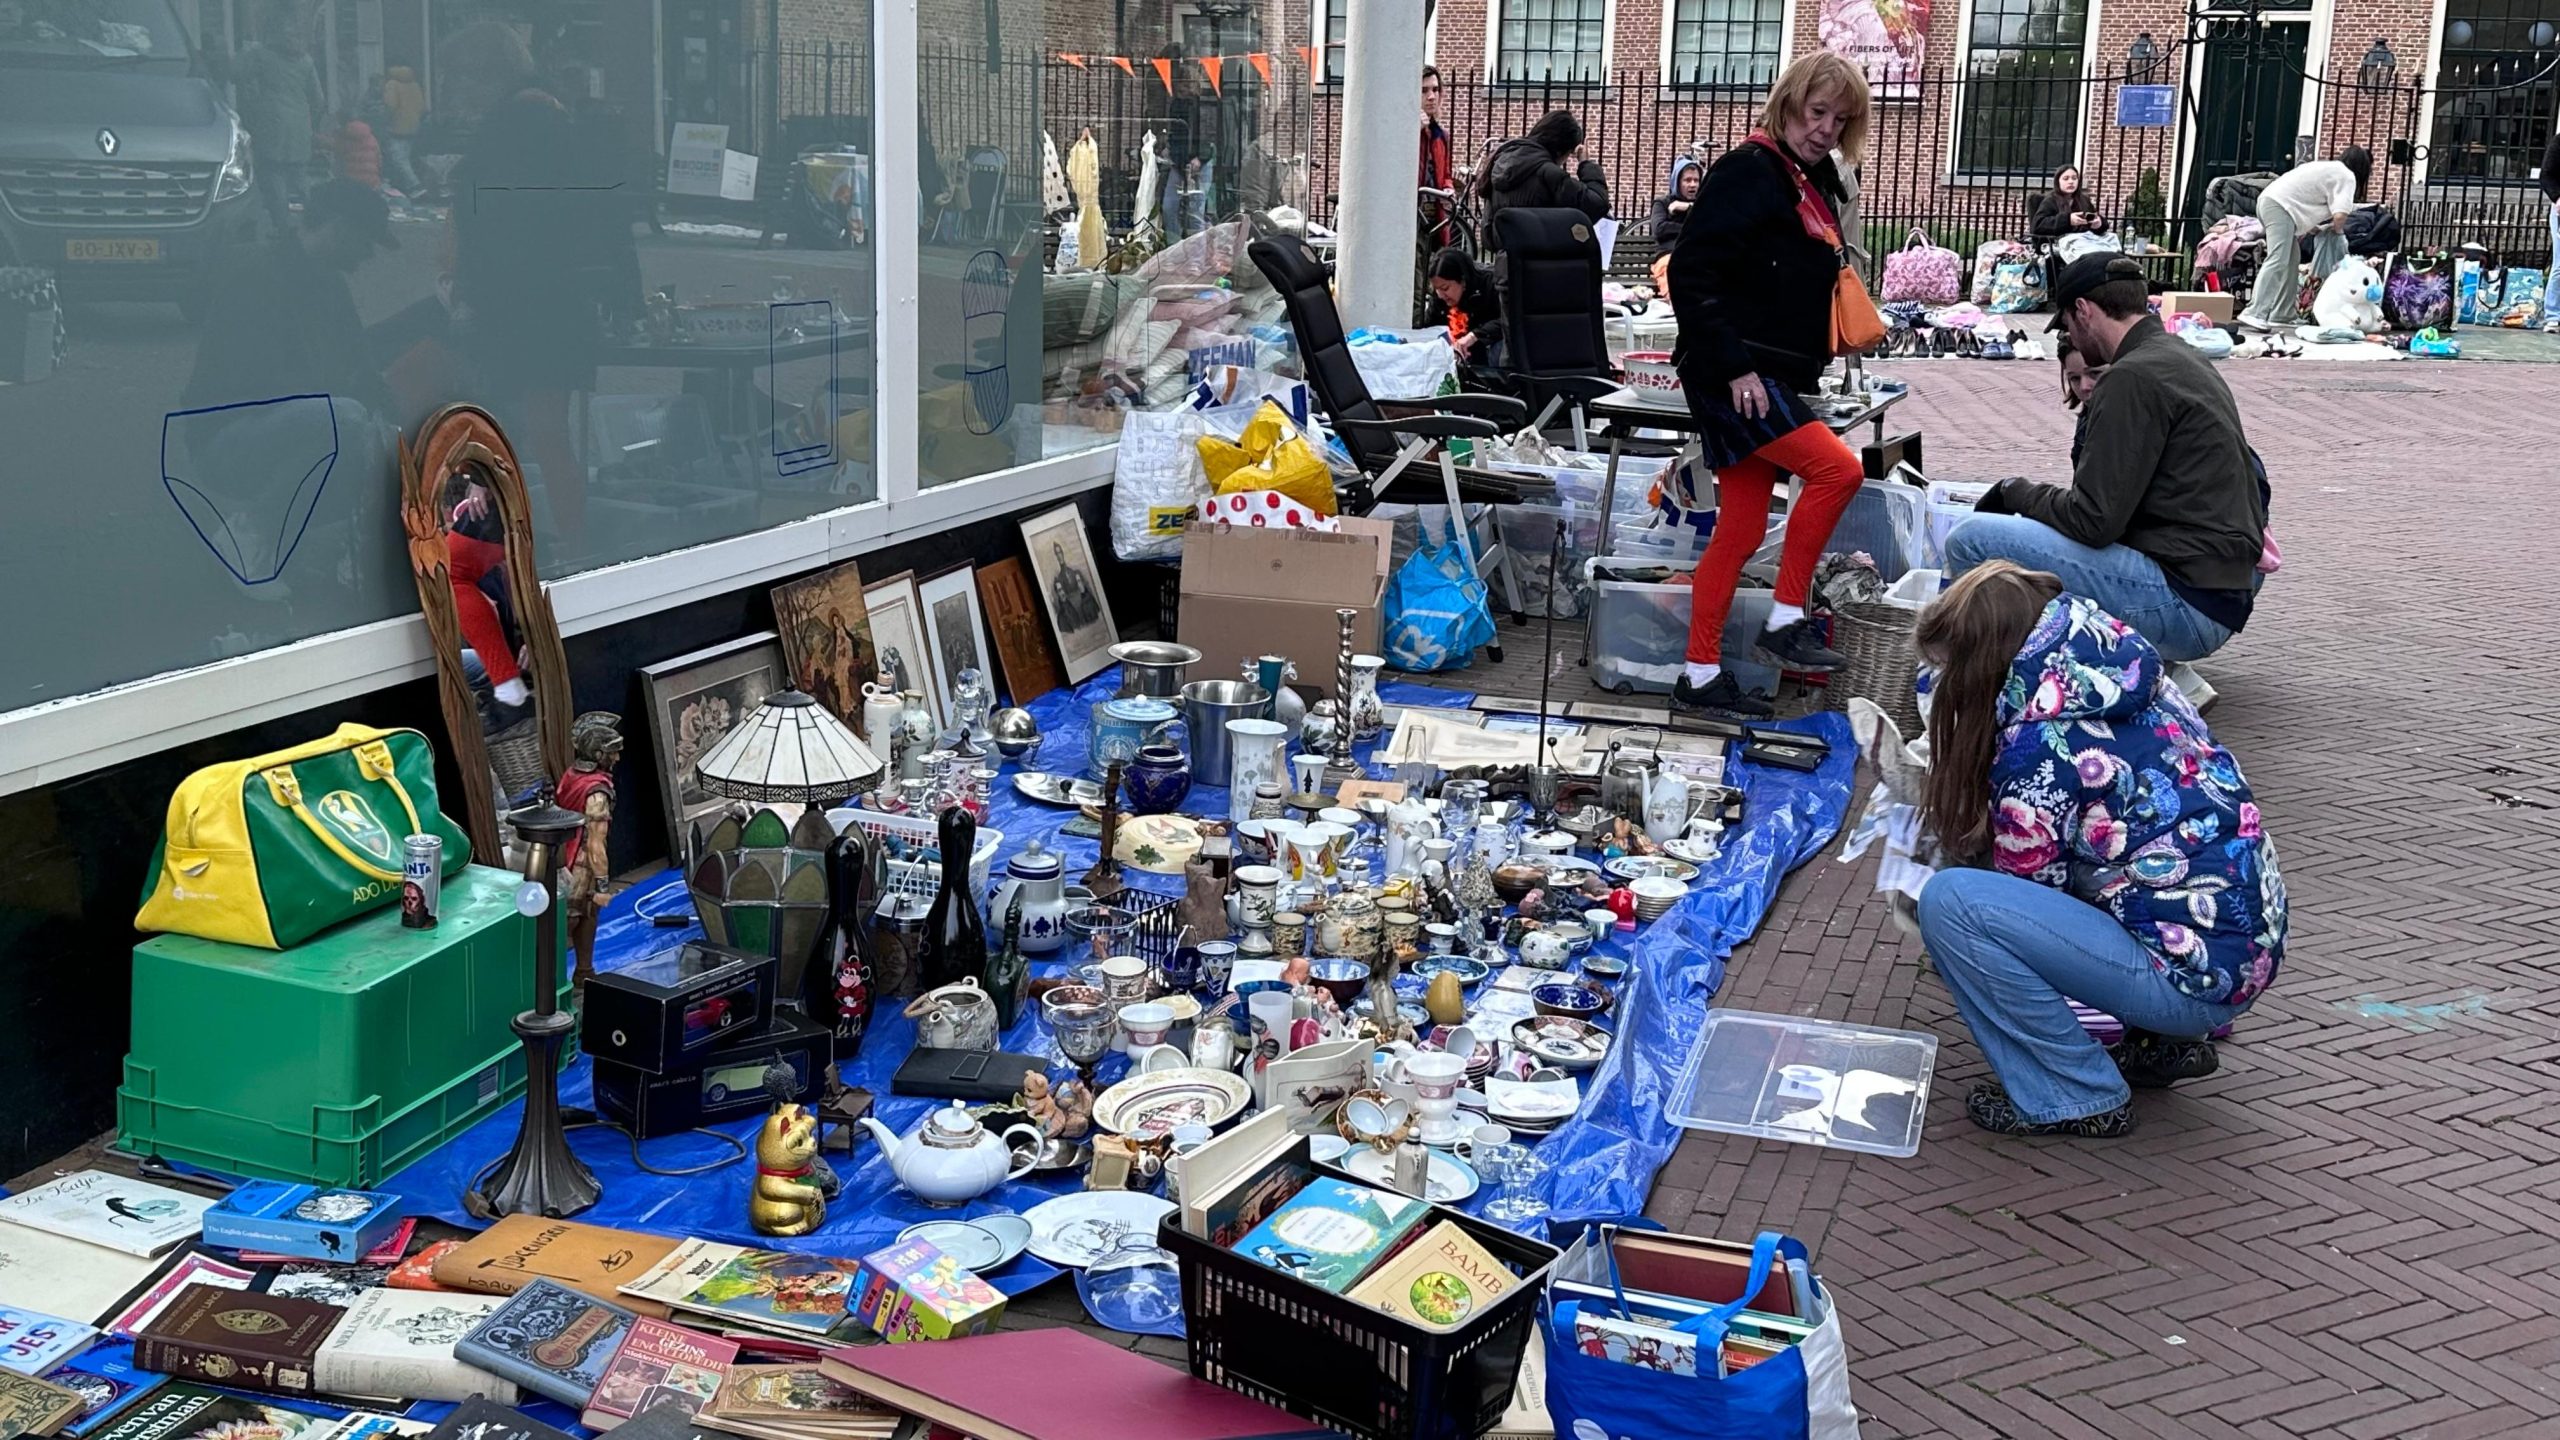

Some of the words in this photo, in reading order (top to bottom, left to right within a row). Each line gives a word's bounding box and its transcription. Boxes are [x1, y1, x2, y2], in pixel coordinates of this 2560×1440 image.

[1849, 45, 1880, 53] FIBERS
[1882, 45, 1896, 53] OF
[352, 881, 381, 905] ADO
[207, 1225, 219, 1233] The
[220, 1227, 242, 1237] English
[637, 1323, 689, 1344] KLEINE
[658, 1338, 708, 1358] GEZINS
[140, 1393, 186, 1417] van
